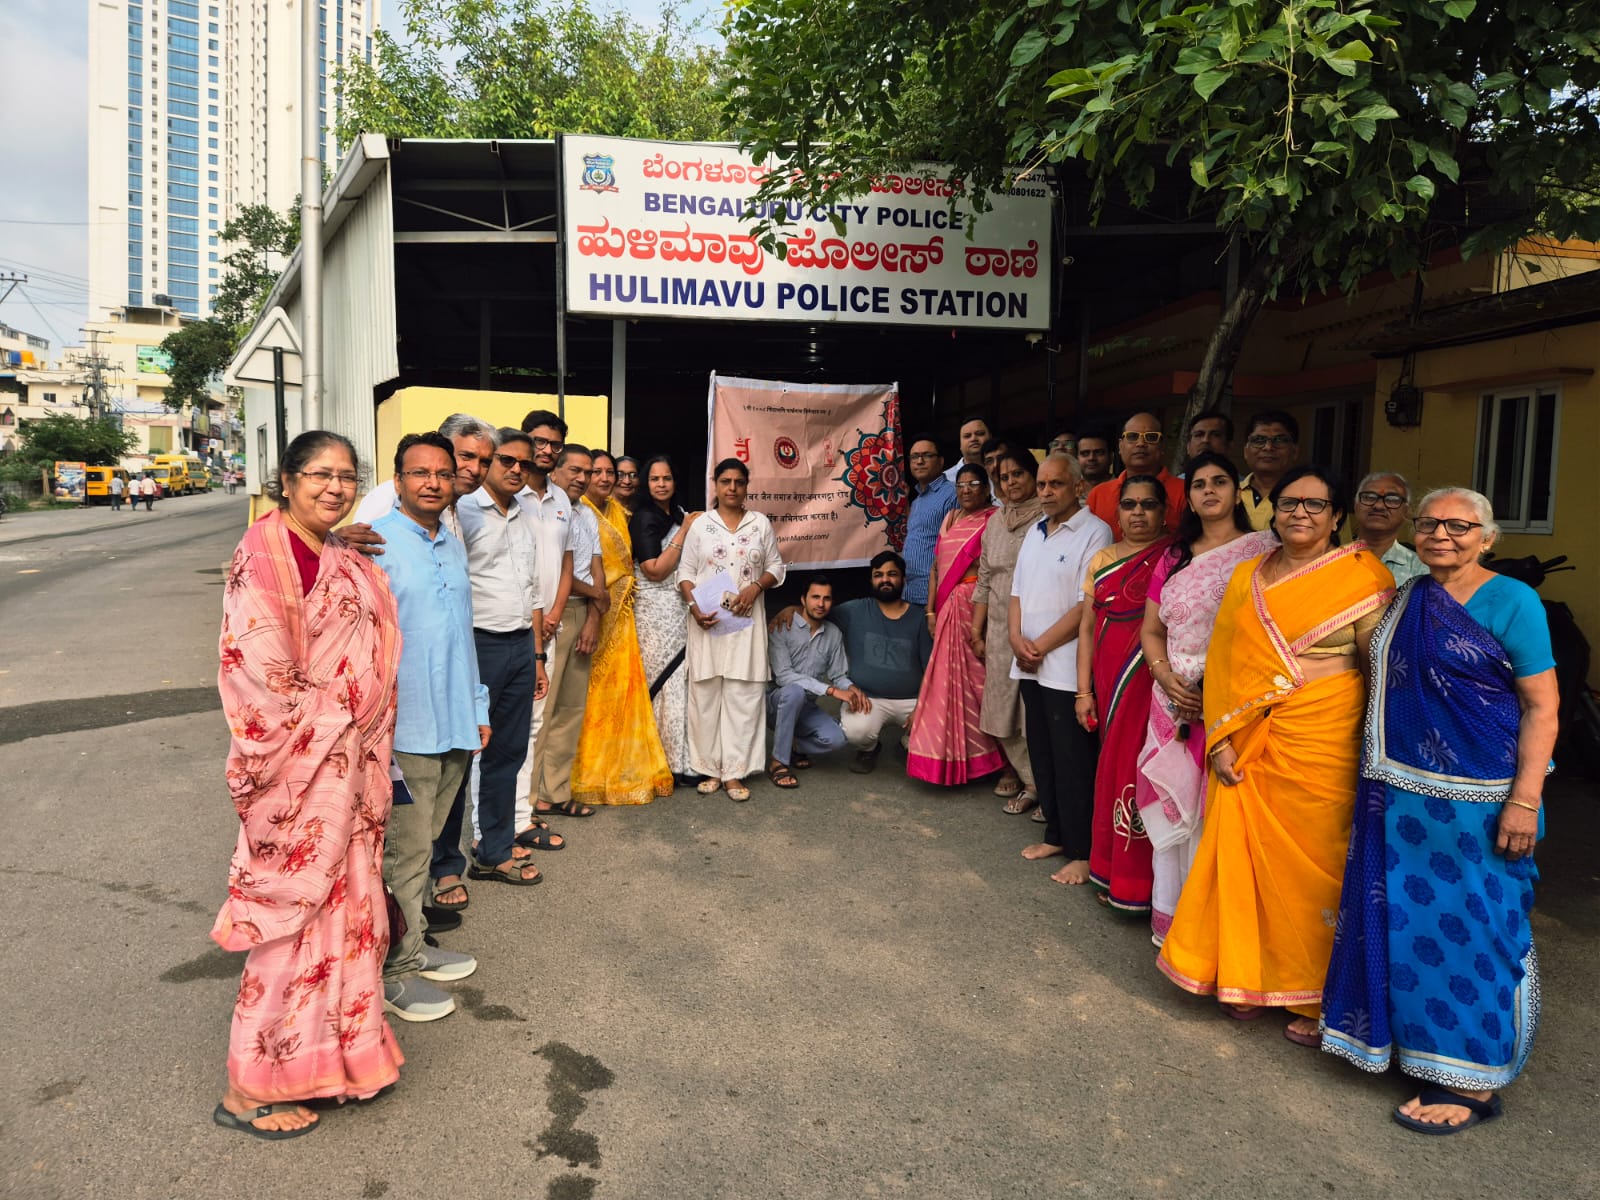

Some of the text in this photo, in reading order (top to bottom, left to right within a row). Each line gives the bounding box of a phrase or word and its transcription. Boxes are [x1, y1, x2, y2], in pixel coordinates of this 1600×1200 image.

[877, 206, 963, 230] POLICE
[577, 215, 765, 275] ಹುಳಿಮಾವು
[589, 273, 1028, 319] HULIMAVU POLICE STATION
